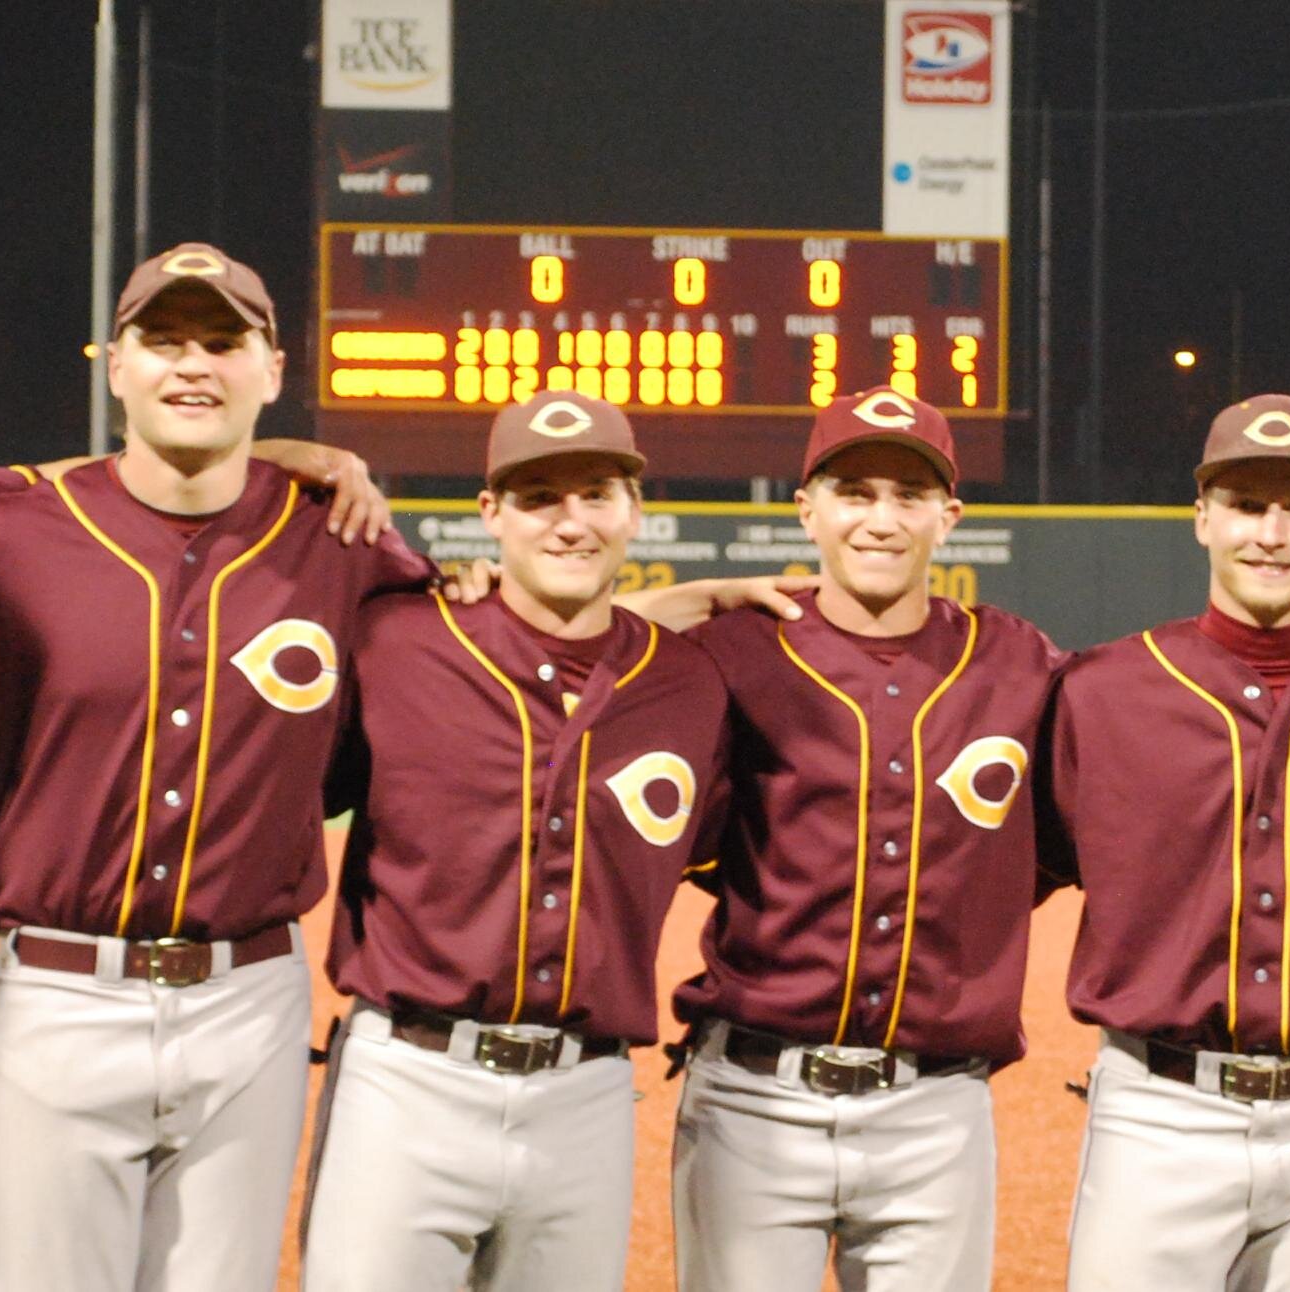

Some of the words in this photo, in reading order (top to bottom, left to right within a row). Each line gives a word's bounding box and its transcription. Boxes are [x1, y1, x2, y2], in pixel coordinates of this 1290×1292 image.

[351, 18, 419, 47] TCF
[339, 44, 432, 72] BANK
[908, 79, 988, 102] Holiday
[338, 169, 431, 197] verizon
[353, 231, 381, 255] AT
[384, 231, 427, 256] BAT
[519, 233, 574, 259] BALL
[652, 235, 729, 262] STRIKE
[802, 237, 847, 263] OUT
[532, 256, 563, 303] 0
[674, 258, 705, 305] 0
[809, 260, 840, 307] 0
[462, 310, 476, 328] 1
[646, 312, 660, 331] 7
[730, 313, 757, 338] 10
[785, 314, 838, 337] RUNS
[455, 329, 482, 366] 2
[559, 331, 574, 366] 1
[813, 333, 837, 370] 3
[893, 334, 917, 371] 3
[952, 335, 977, 373] 2
[810, 369, 836, 407] 2
[962, 375, 977, 407] 1
